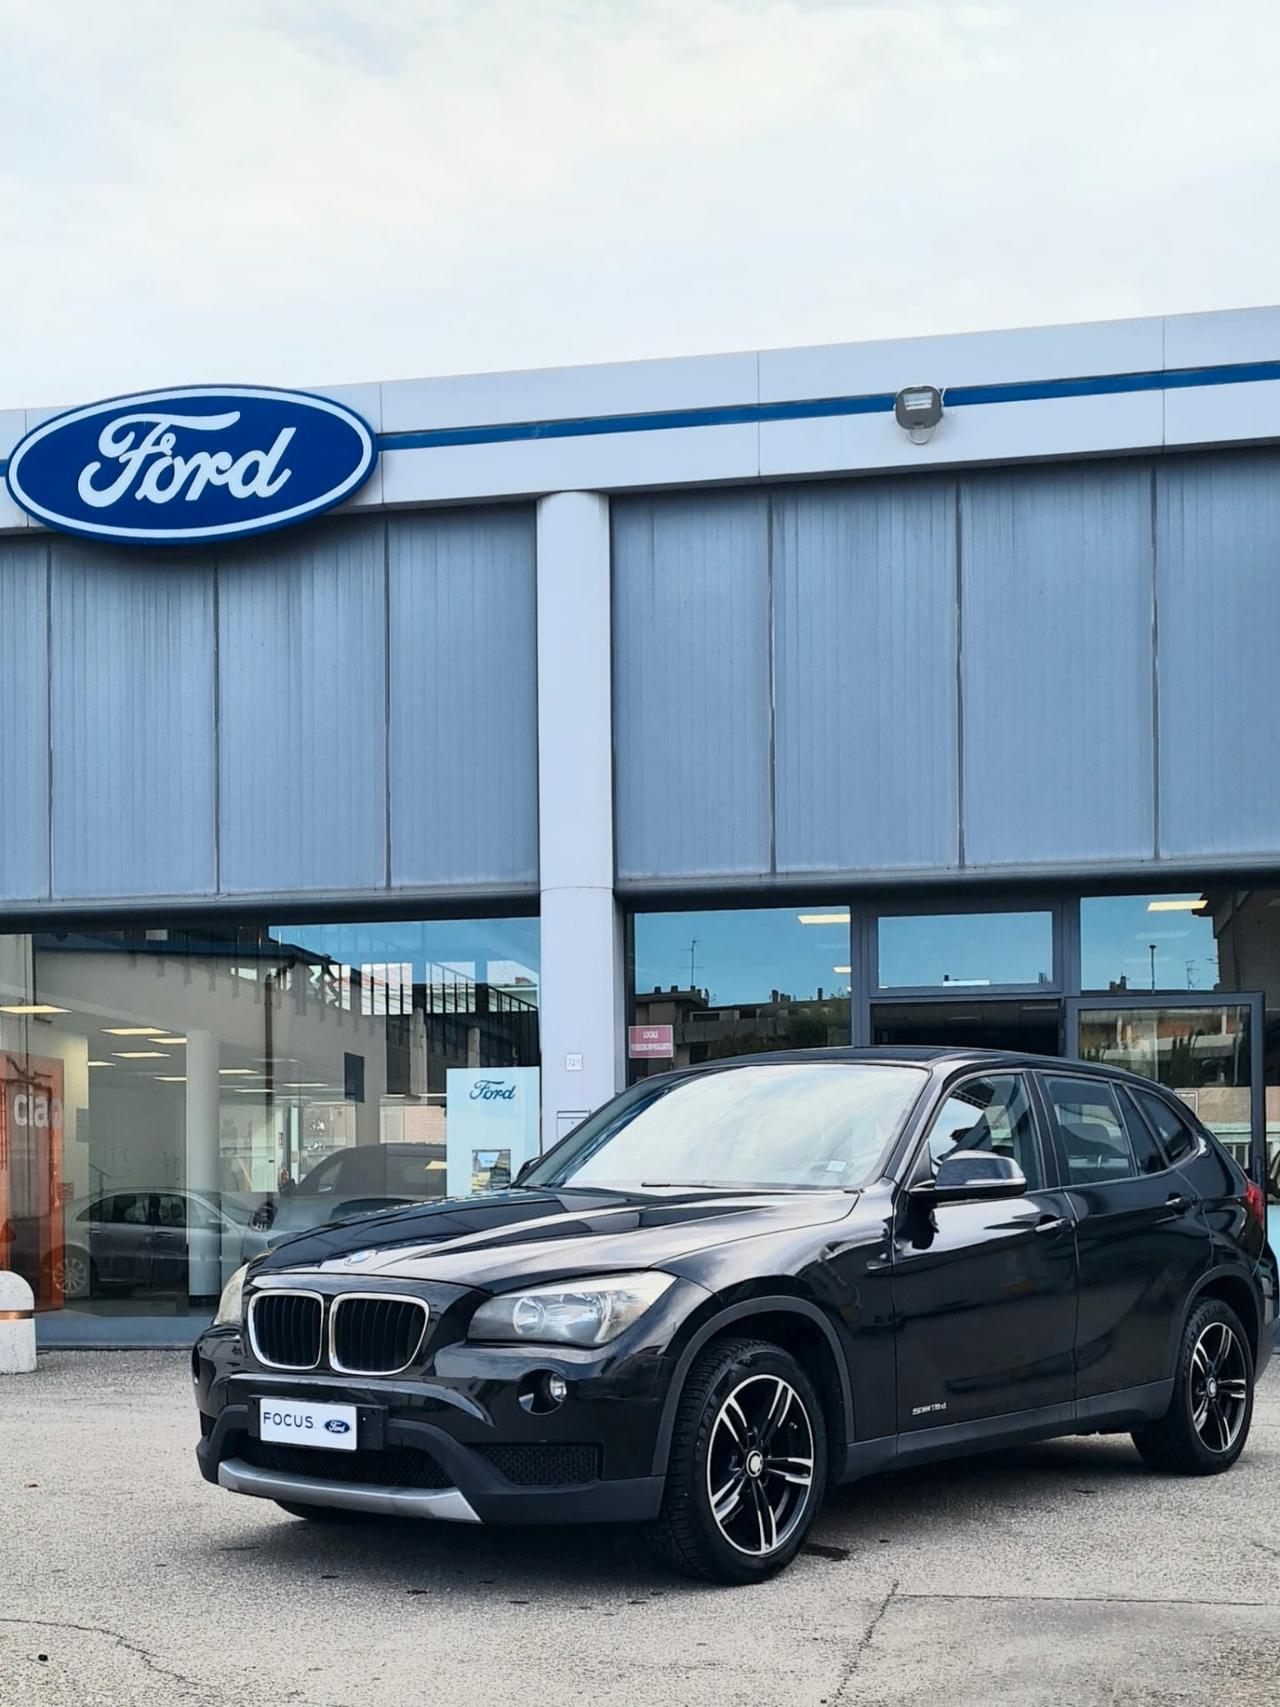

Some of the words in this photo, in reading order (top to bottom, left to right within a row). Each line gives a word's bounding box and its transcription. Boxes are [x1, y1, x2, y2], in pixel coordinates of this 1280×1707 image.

[78, 411, 296, 507] Ford
[469, 1080, 516, 1100] Ford
[263, 1412, 314, 1429] FOCUS
